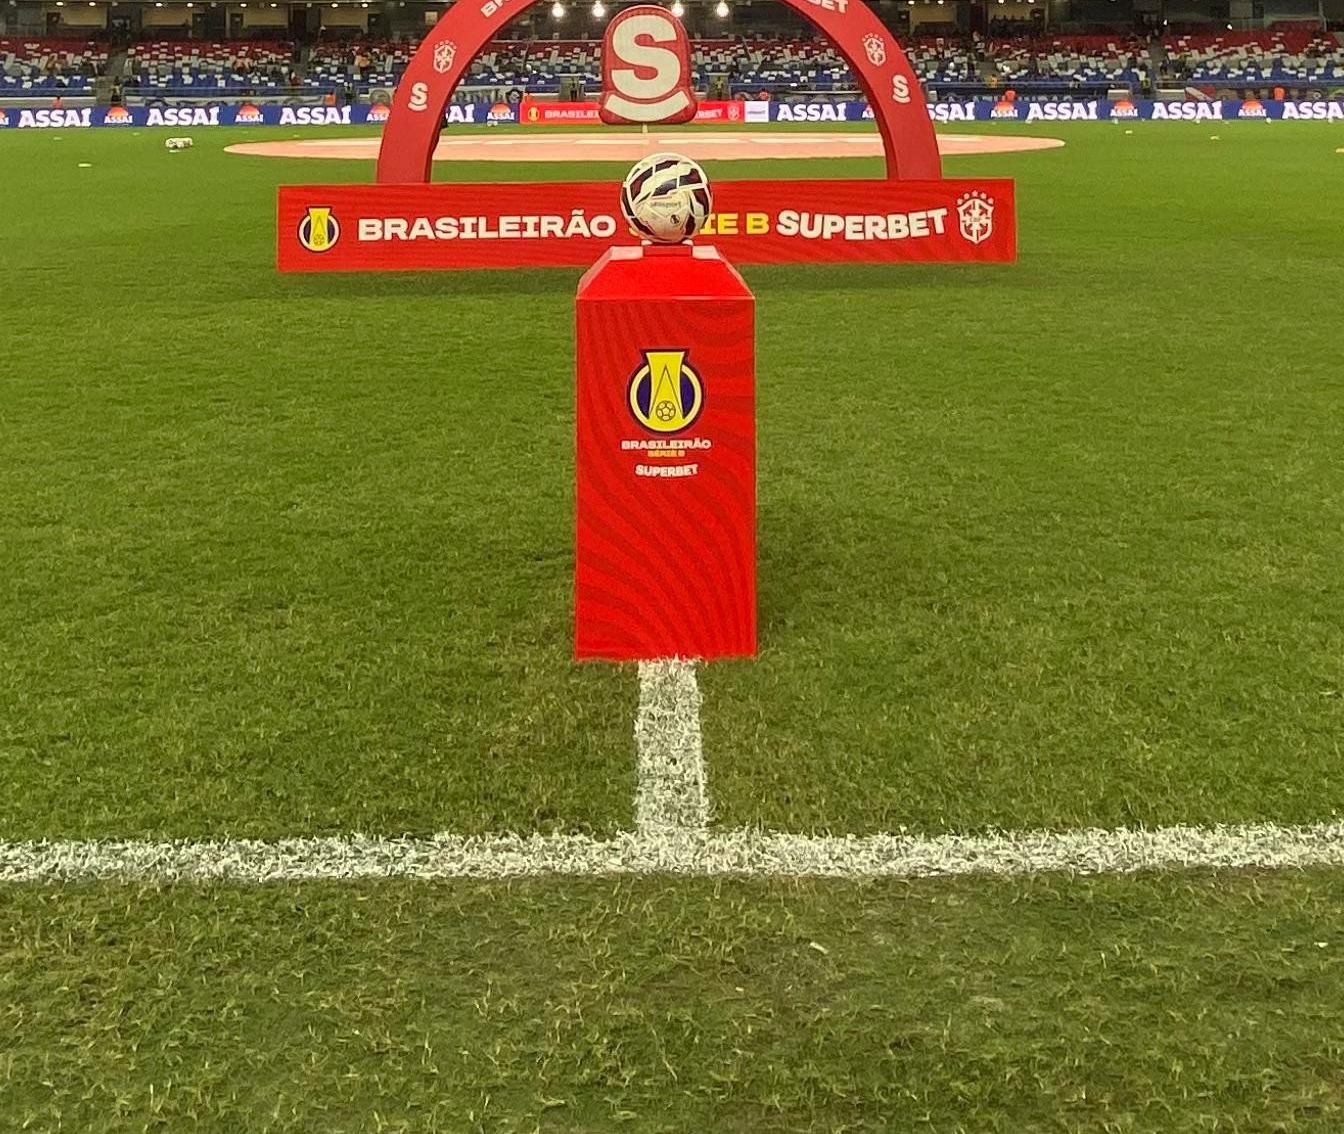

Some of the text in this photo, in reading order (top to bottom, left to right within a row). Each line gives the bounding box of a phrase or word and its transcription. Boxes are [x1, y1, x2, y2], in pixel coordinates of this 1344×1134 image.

[358, 209, 617, 241] BRASILEIRÃO
[746, 212, 770, 235] B
[777, 208, 948, 241] SUPERBET
[621, 438, 712, 450] BRASILEIRÃO
[635, 464, 698, 477] SUPERBET
